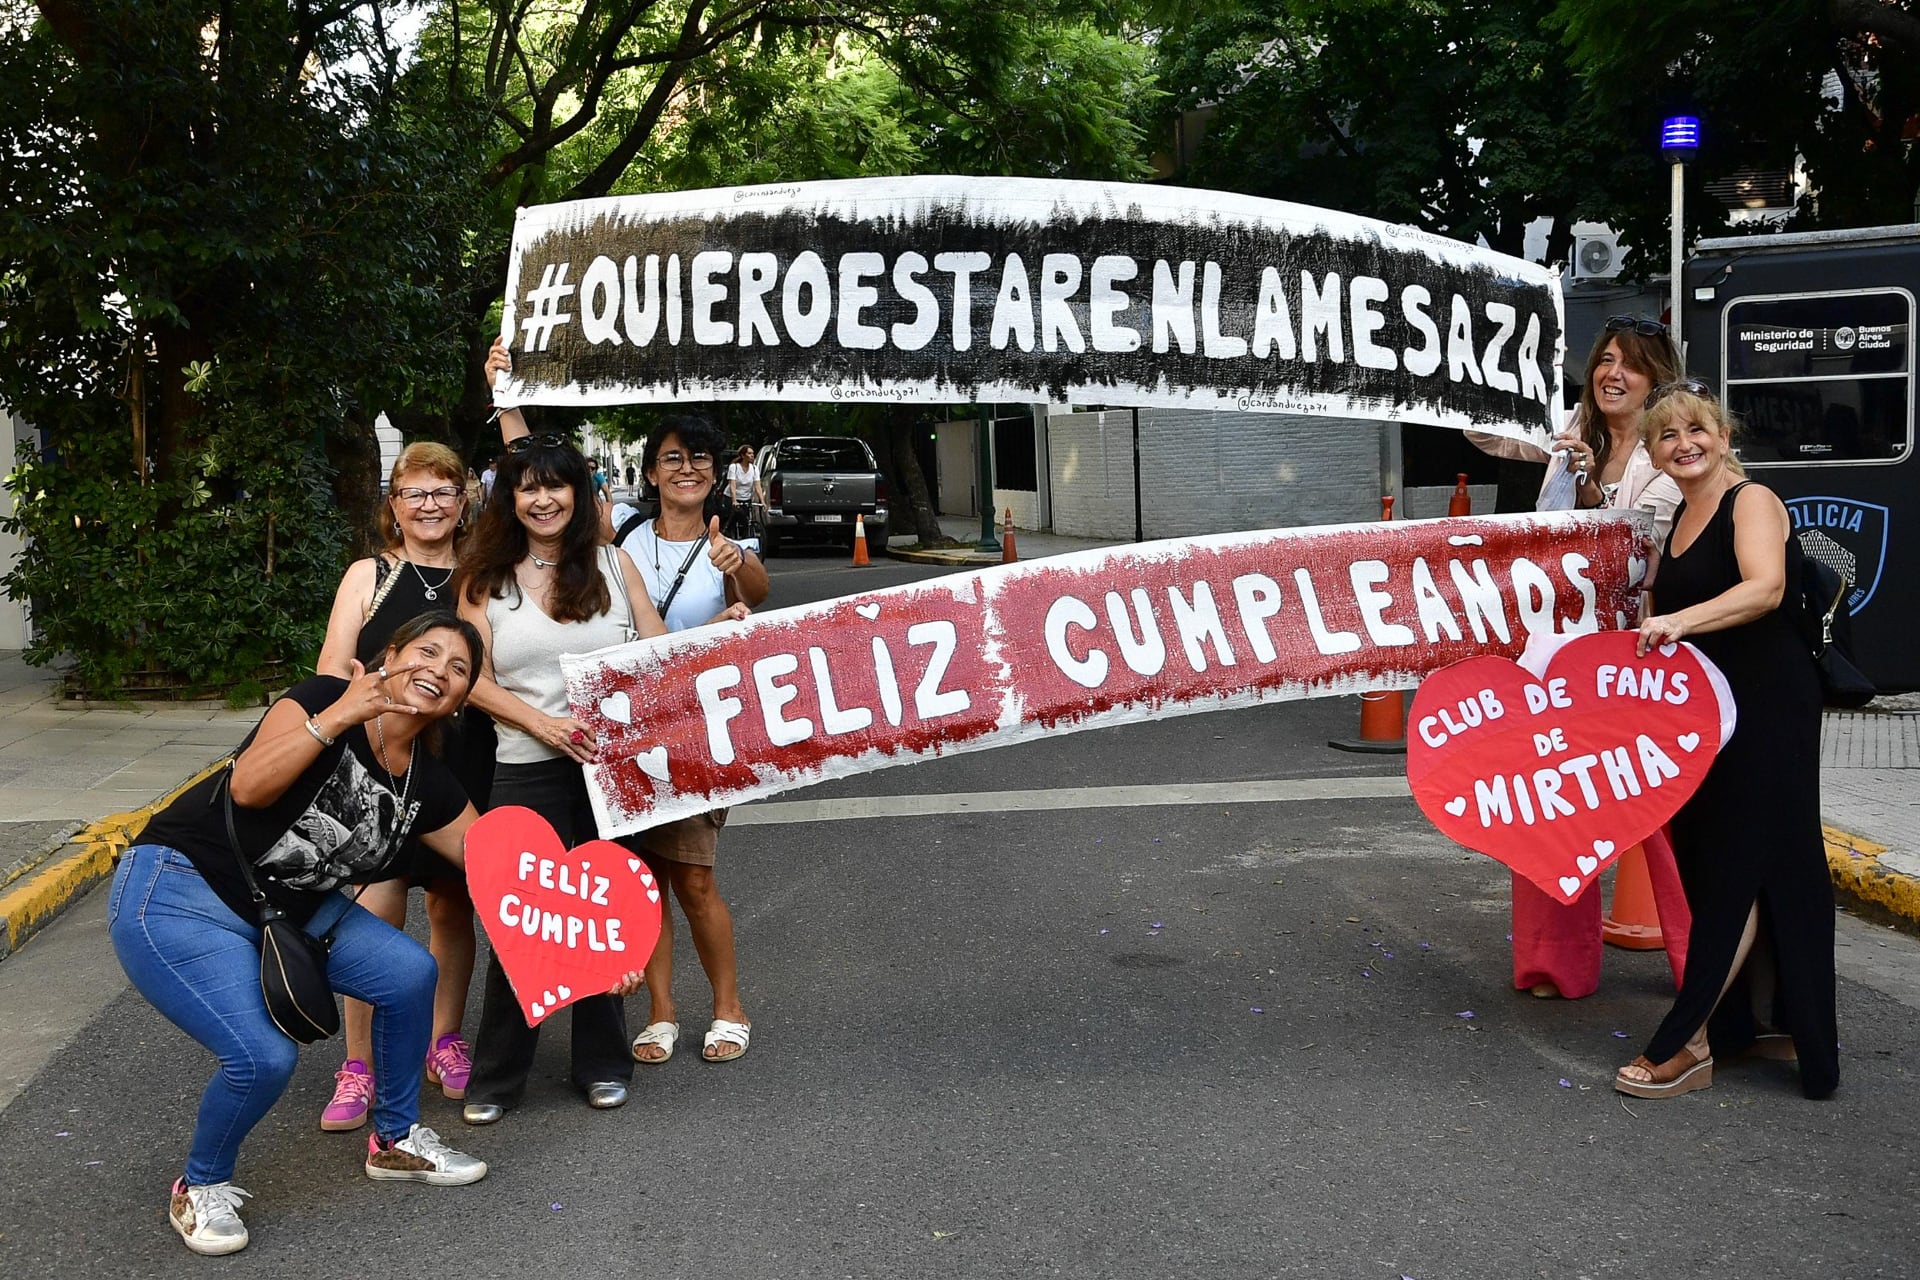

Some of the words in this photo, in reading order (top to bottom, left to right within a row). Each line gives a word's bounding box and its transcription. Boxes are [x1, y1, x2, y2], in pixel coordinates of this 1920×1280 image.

[521, 250, 1547, 405] #QUIEROESTARENLAMESAZA
[1740, 329, 1797, 341] Ministerio
[1798, 328, 1814, 339] de
[1858, 325, 1892, 334] Buenos
[1858, 333, 1883, 341] Aires
[1754, 339, 1814, 353] Seguridad
[1858, 340, 1890, 349] Ciudad
[1847, 588, 1866, 607] AIRES
[694, 602, 972, 766] FELIZ
[1044, 534, 1598, 688] CUMPLEAÑOS
[1417, 688, 1505, 749] CLUB
[1523, 677, 1573, 715] DE
[1596, 664, 1690, 705] FANS
[1532, 727, 1569, 758] DE
[1473, 733, 1680, 829] MIRTHA
[518, 851, 611, 907] FELIZ
[498, 893, 626, 953] CUMPLE
